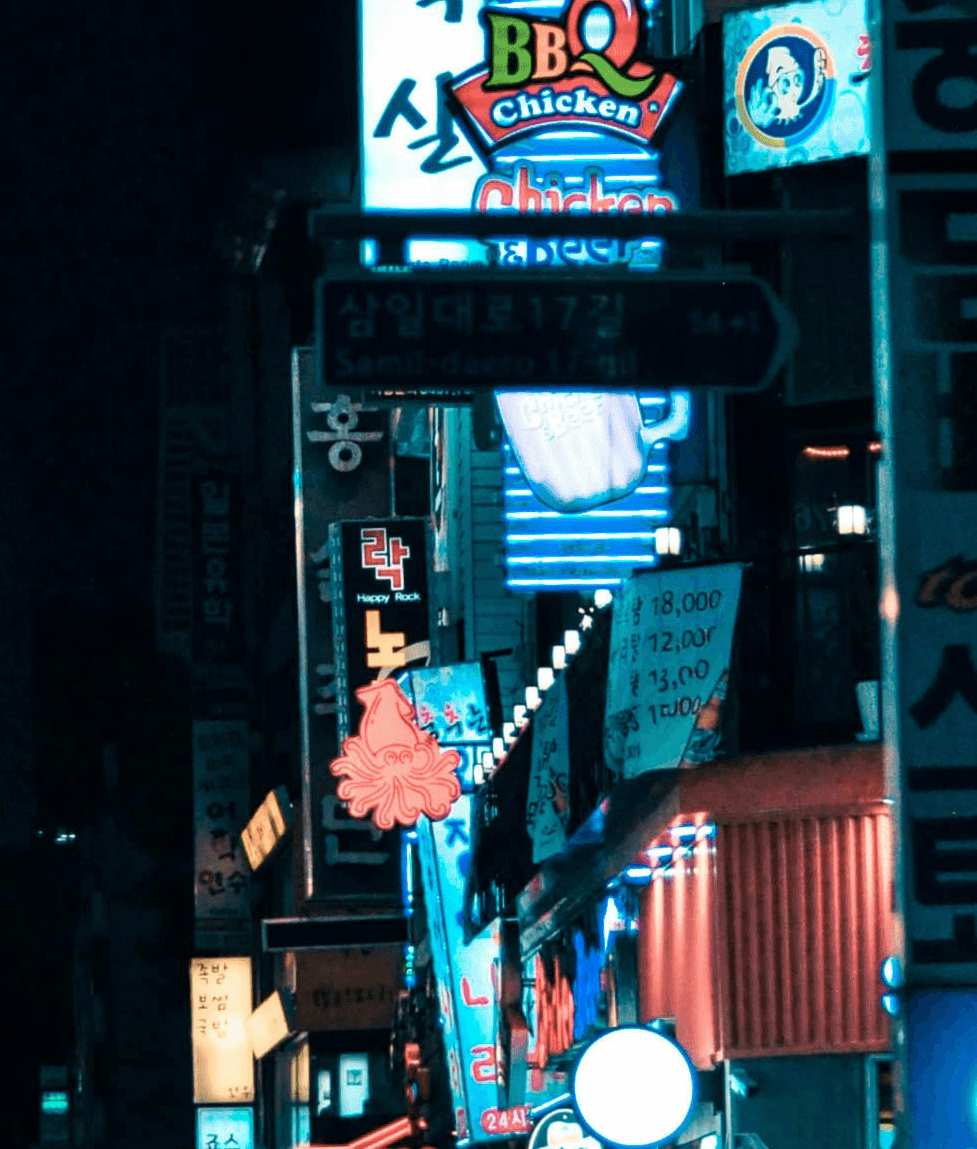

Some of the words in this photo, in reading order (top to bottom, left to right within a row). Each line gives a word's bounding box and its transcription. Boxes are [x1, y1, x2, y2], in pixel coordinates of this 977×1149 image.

[491, 86, 641, 129] Chicken
[362, 528, 410, 591] 락
[357, 592, 390, 604] Happy
[395, 591, 422, 602] Rock
